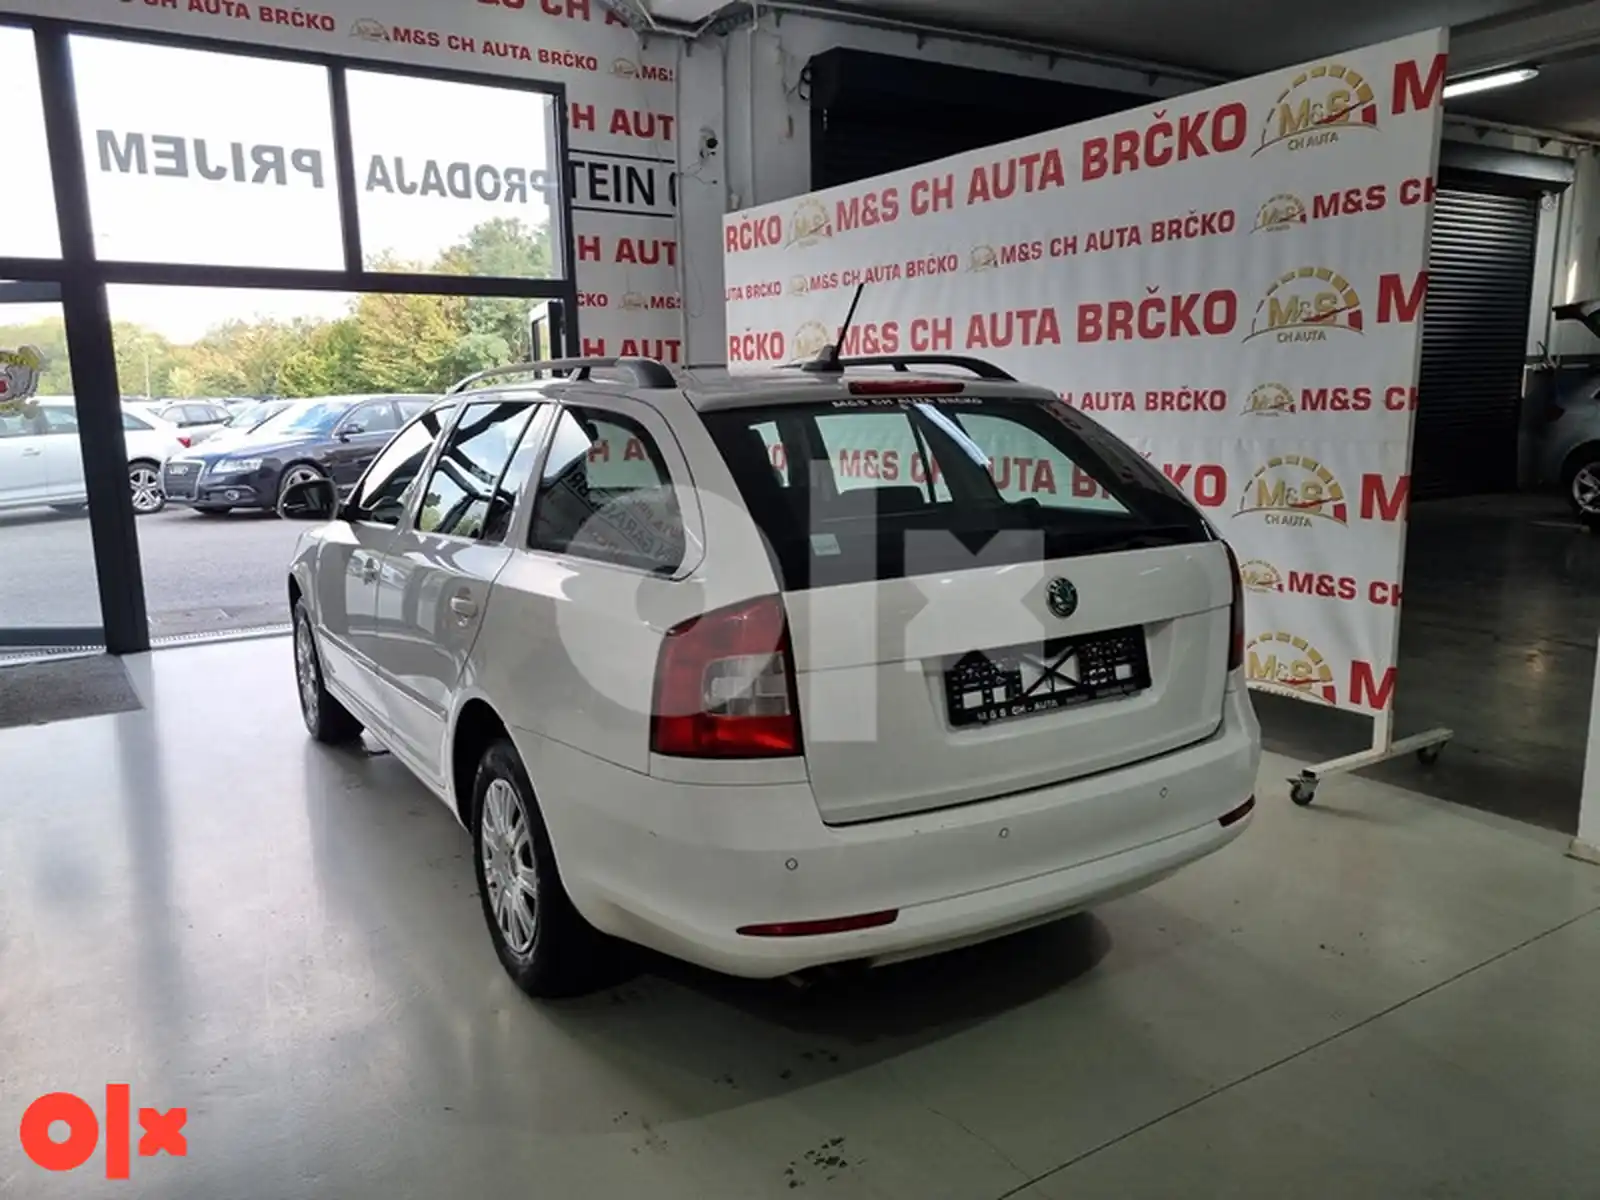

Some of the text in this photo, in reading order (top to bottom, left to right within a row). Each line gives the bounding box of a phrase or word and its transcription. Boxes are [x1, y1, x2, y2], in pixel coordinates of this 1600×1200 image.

[188, 0, 250, 20] AUTA
[258, 6, 335, 32] BRČKO
[392, 27, 598, 71] M&S CH AUTA BRČKO
[1279, 89, 1350, 138] M&S
[1306, 131, 1339, 148] AUTA
[726, 211, 782, 252] RČKO
[836, 187, 899, 232] M&S
[911, 174, 954, 216] CH
[967, 149, 1065, 205] AUTA
[1082, 102, 1247, 182] BRČKO
[1312, 184, 1386, 219] M&S
[810, 273, 838, 290] M&S
[842, 269, 861, 286] CH
[865, 263, 901, 282] AUTA
[906, 253, 958, 278] BRČKO
[1001, 240, 1043, 265] M&S
[1050, 235, 1077, 257] CH
[1085, 225, 1142, 253] AUTA
[1151, 209, 1236, 243] BRČKO
[729, 326, 785, 361] RČKO
[837, 321, 899, 356] M&S
[911, 316, 952, 352] CH
[966, 307, 1061, 349] AUTA
[1077, 285, 1238, 343] BRČKO
[1269, 291, 1338, 328] M&S
[1294, 331, 1326, 342] AUTA
[1081, 391, 1136, 411] AUTA
[1145, 384, 1226, 412] BRČKO
[1302, 387, 1371, 412] M&S
[840, 448, 898, 481] M&S
[1257, 478, 1322, 512] M&S
[1283, 514, 1312, 528] AUTA
[1289, 571, 1356, 600] M&S
[1247, 651, 1312, 691] M&S
